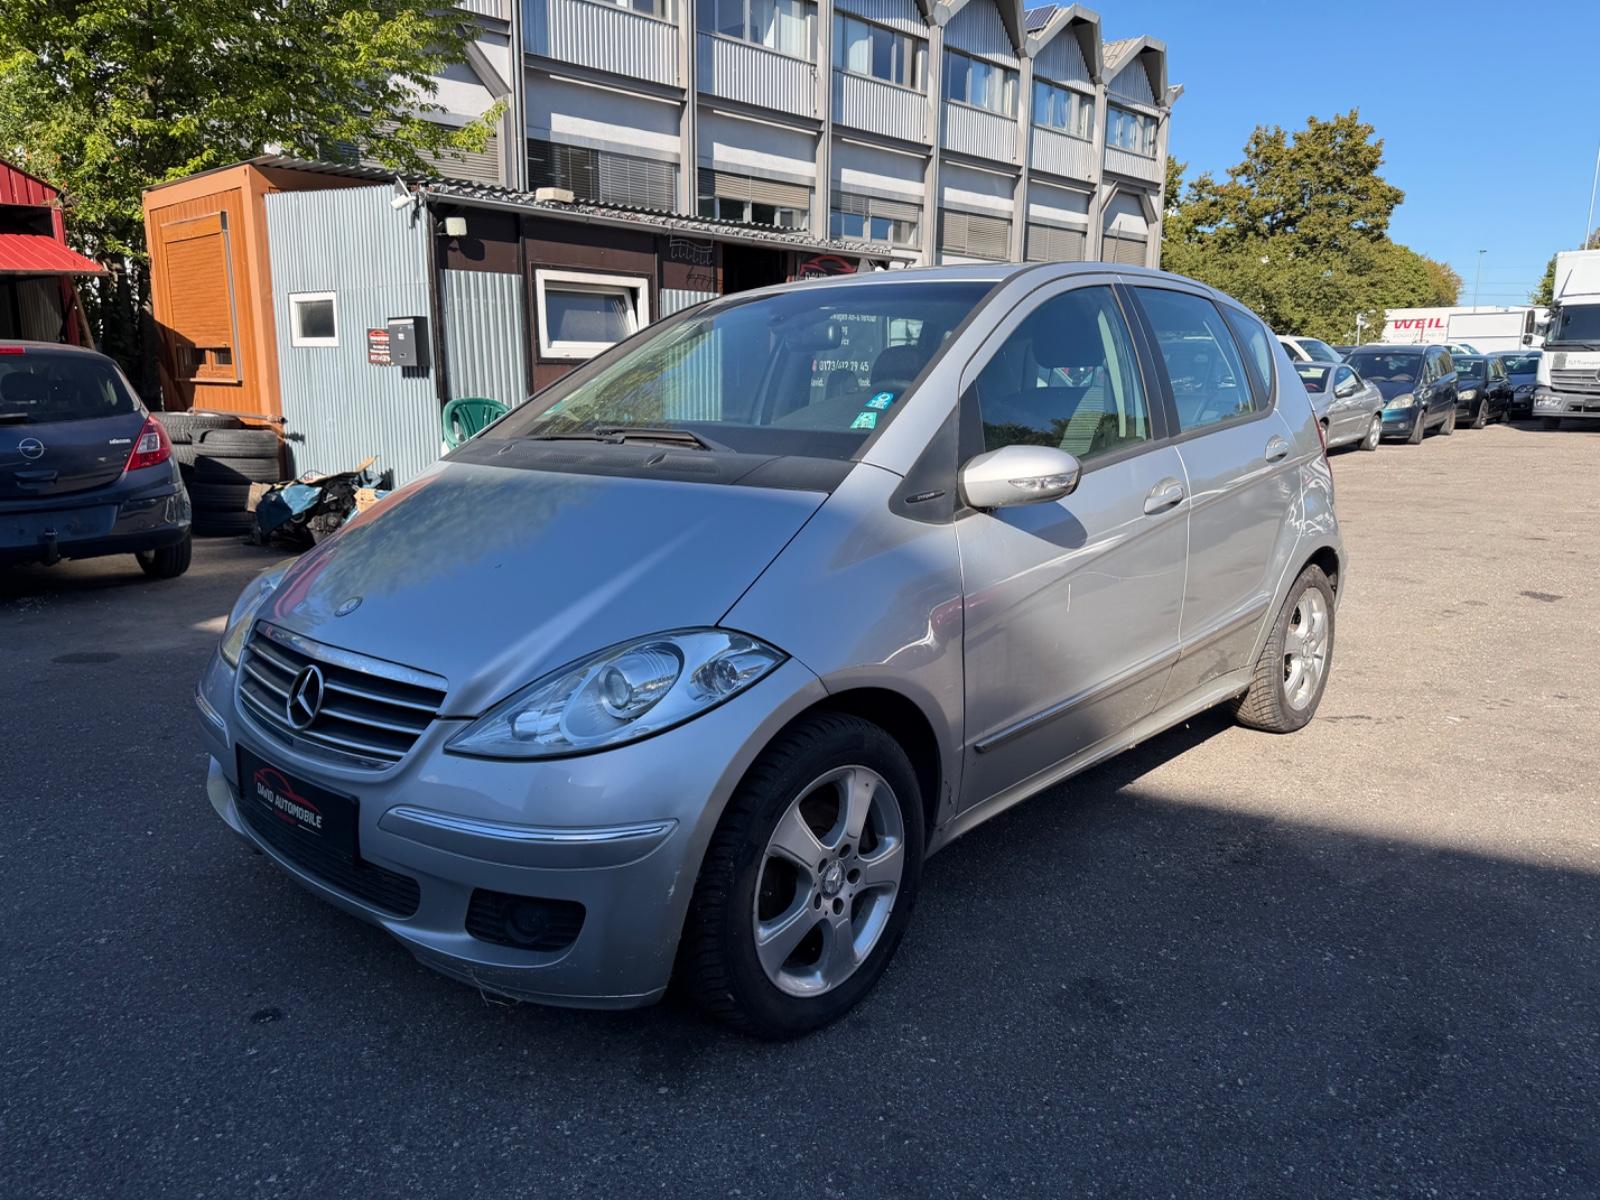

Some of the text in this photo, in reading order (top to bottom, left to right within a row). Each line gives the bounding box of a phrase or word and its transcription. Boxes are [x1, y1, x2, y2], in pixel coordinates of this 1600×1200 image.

[860, 361, 870, 372] 45
[257, 782, 274, 803] DAVID
[275, 795, 322, 829] AUTOMOBILE
